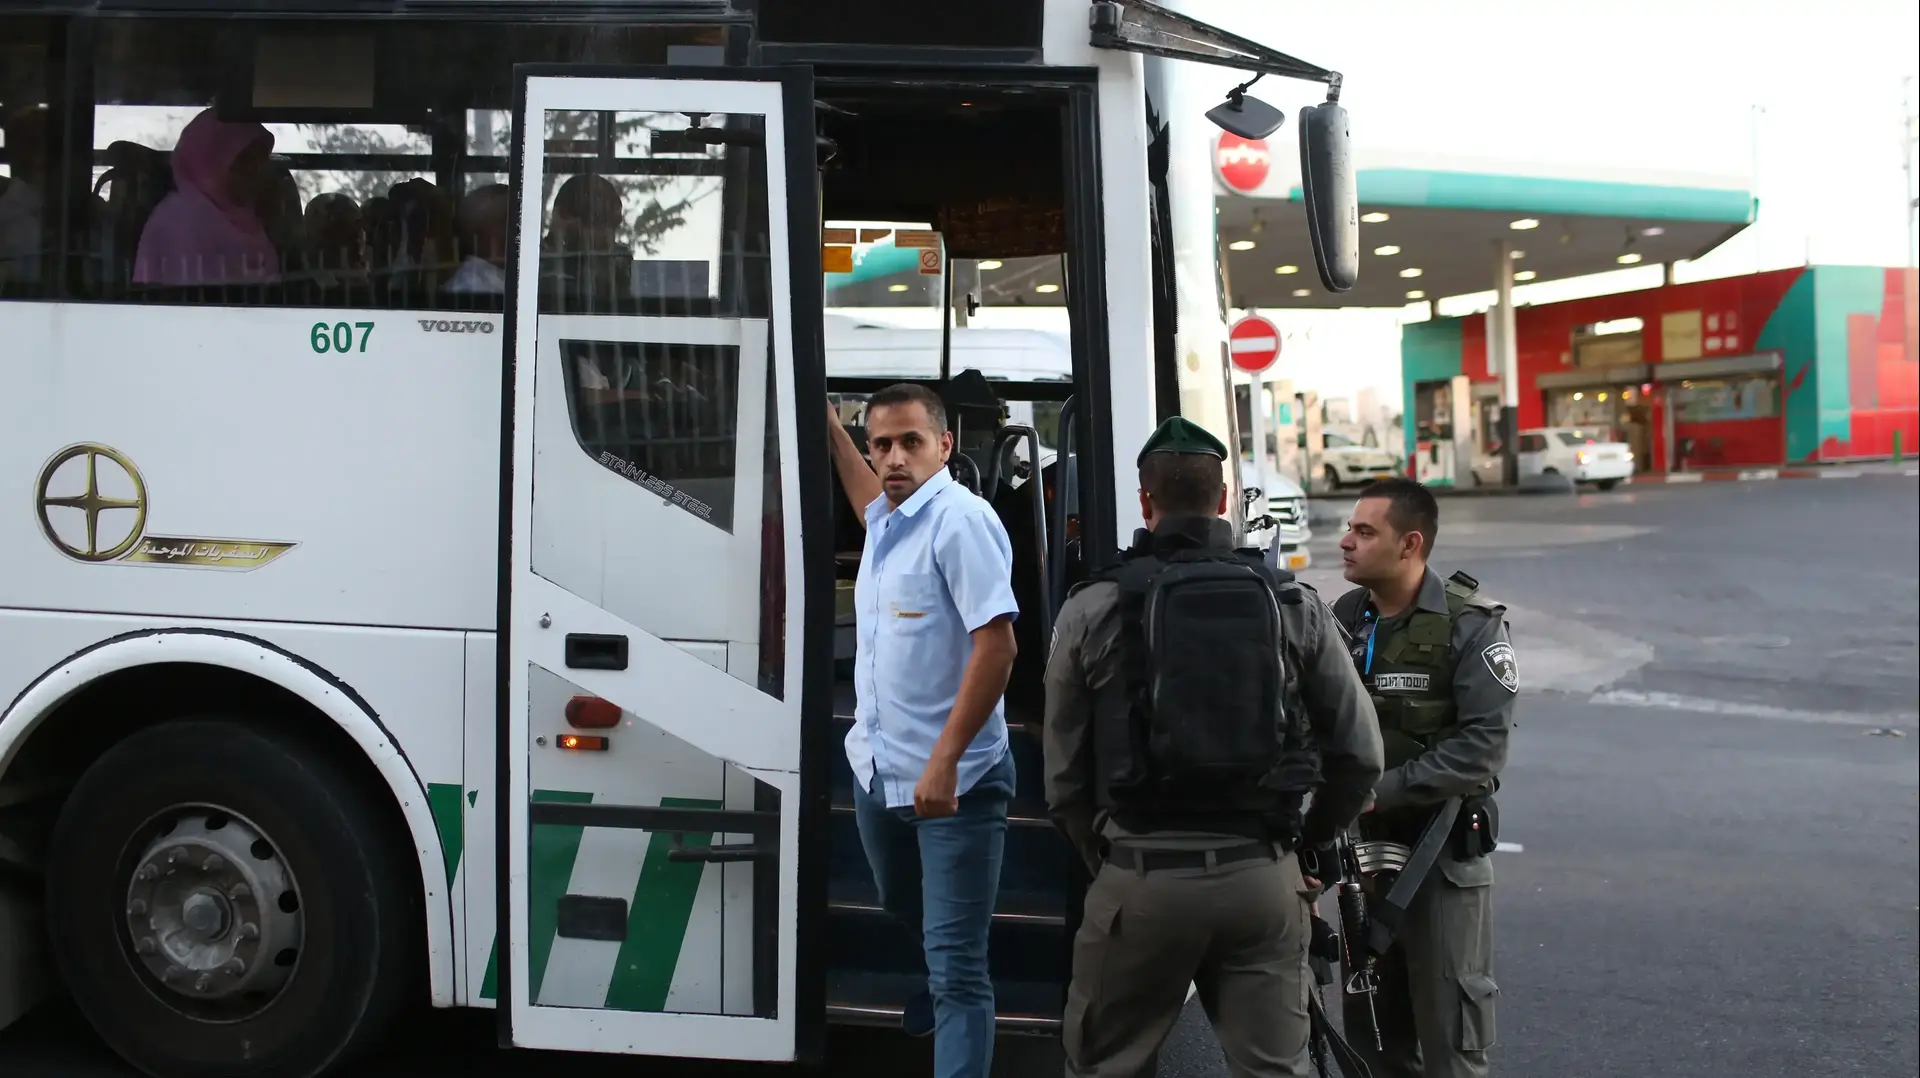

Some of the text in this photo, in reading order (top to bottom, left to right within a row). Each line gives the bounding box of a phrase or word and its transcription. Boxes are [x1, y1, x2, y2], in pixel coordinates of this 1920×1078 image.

[417, 319, 495, 334] VOLVO
[310, 321, 375, 354] 607
[672, 490, 713, 519] STEEL
[140, 540, 196, 560] الموحدة
[1400, 676, 1429, 689] משמר
